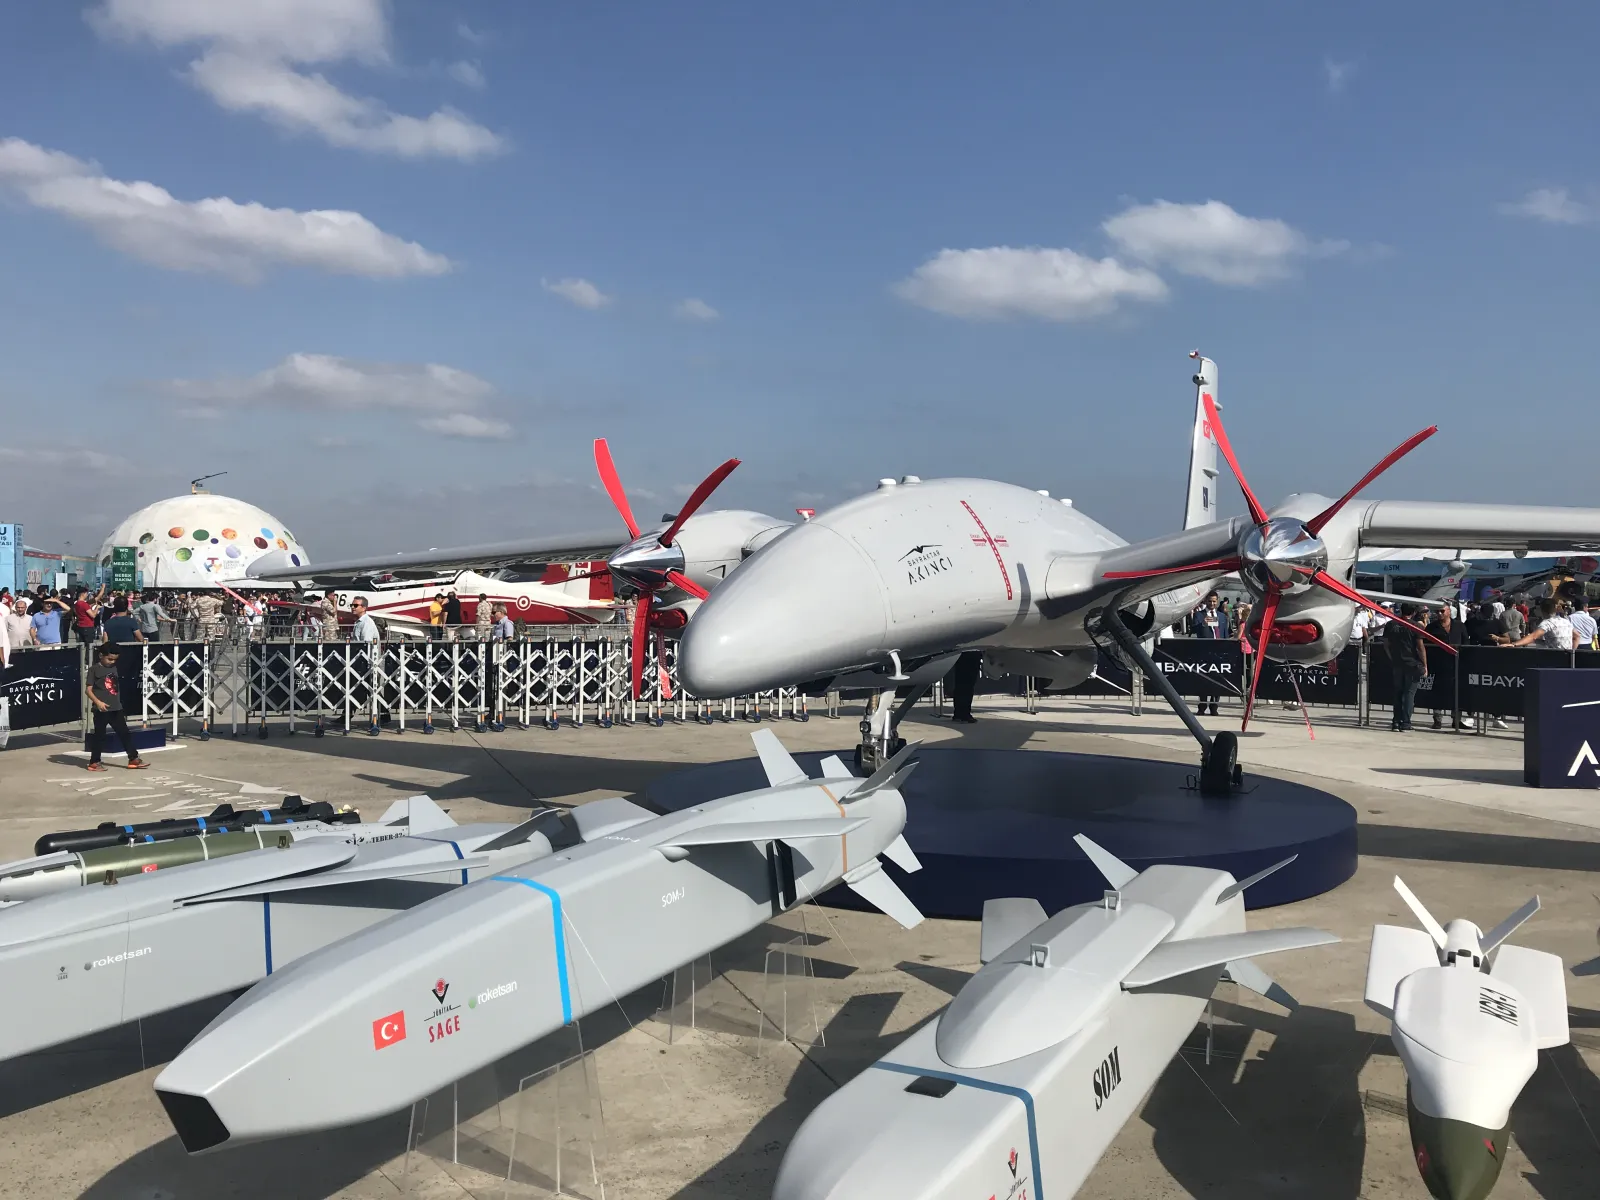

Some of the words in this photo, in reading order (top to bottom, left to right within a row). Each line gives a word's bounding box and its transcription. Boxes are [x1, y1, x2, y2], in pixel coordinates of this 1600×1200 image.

[907, 550, 941, 567] BAYRAKTAR
[908, 556, 953, 585] AKINCI
[1164, 662, 1232, 674] BAYKAR
[9, 682, 55, 693] BAYRAKTAR
[1275, 674, 1337, 685] AKINCI
[1481, 674, 1525, 688] BAYK
[8, 688, 63, 707] KINCI
[661, 886, 685, 908] SOM-J
[92, 946, 152, 968] roketsan
[477, 980, 518, 1005] roketsan
[428, 1015, 461, 1044] SAGE
[1093, 1045, 1122, 1112] SOM
